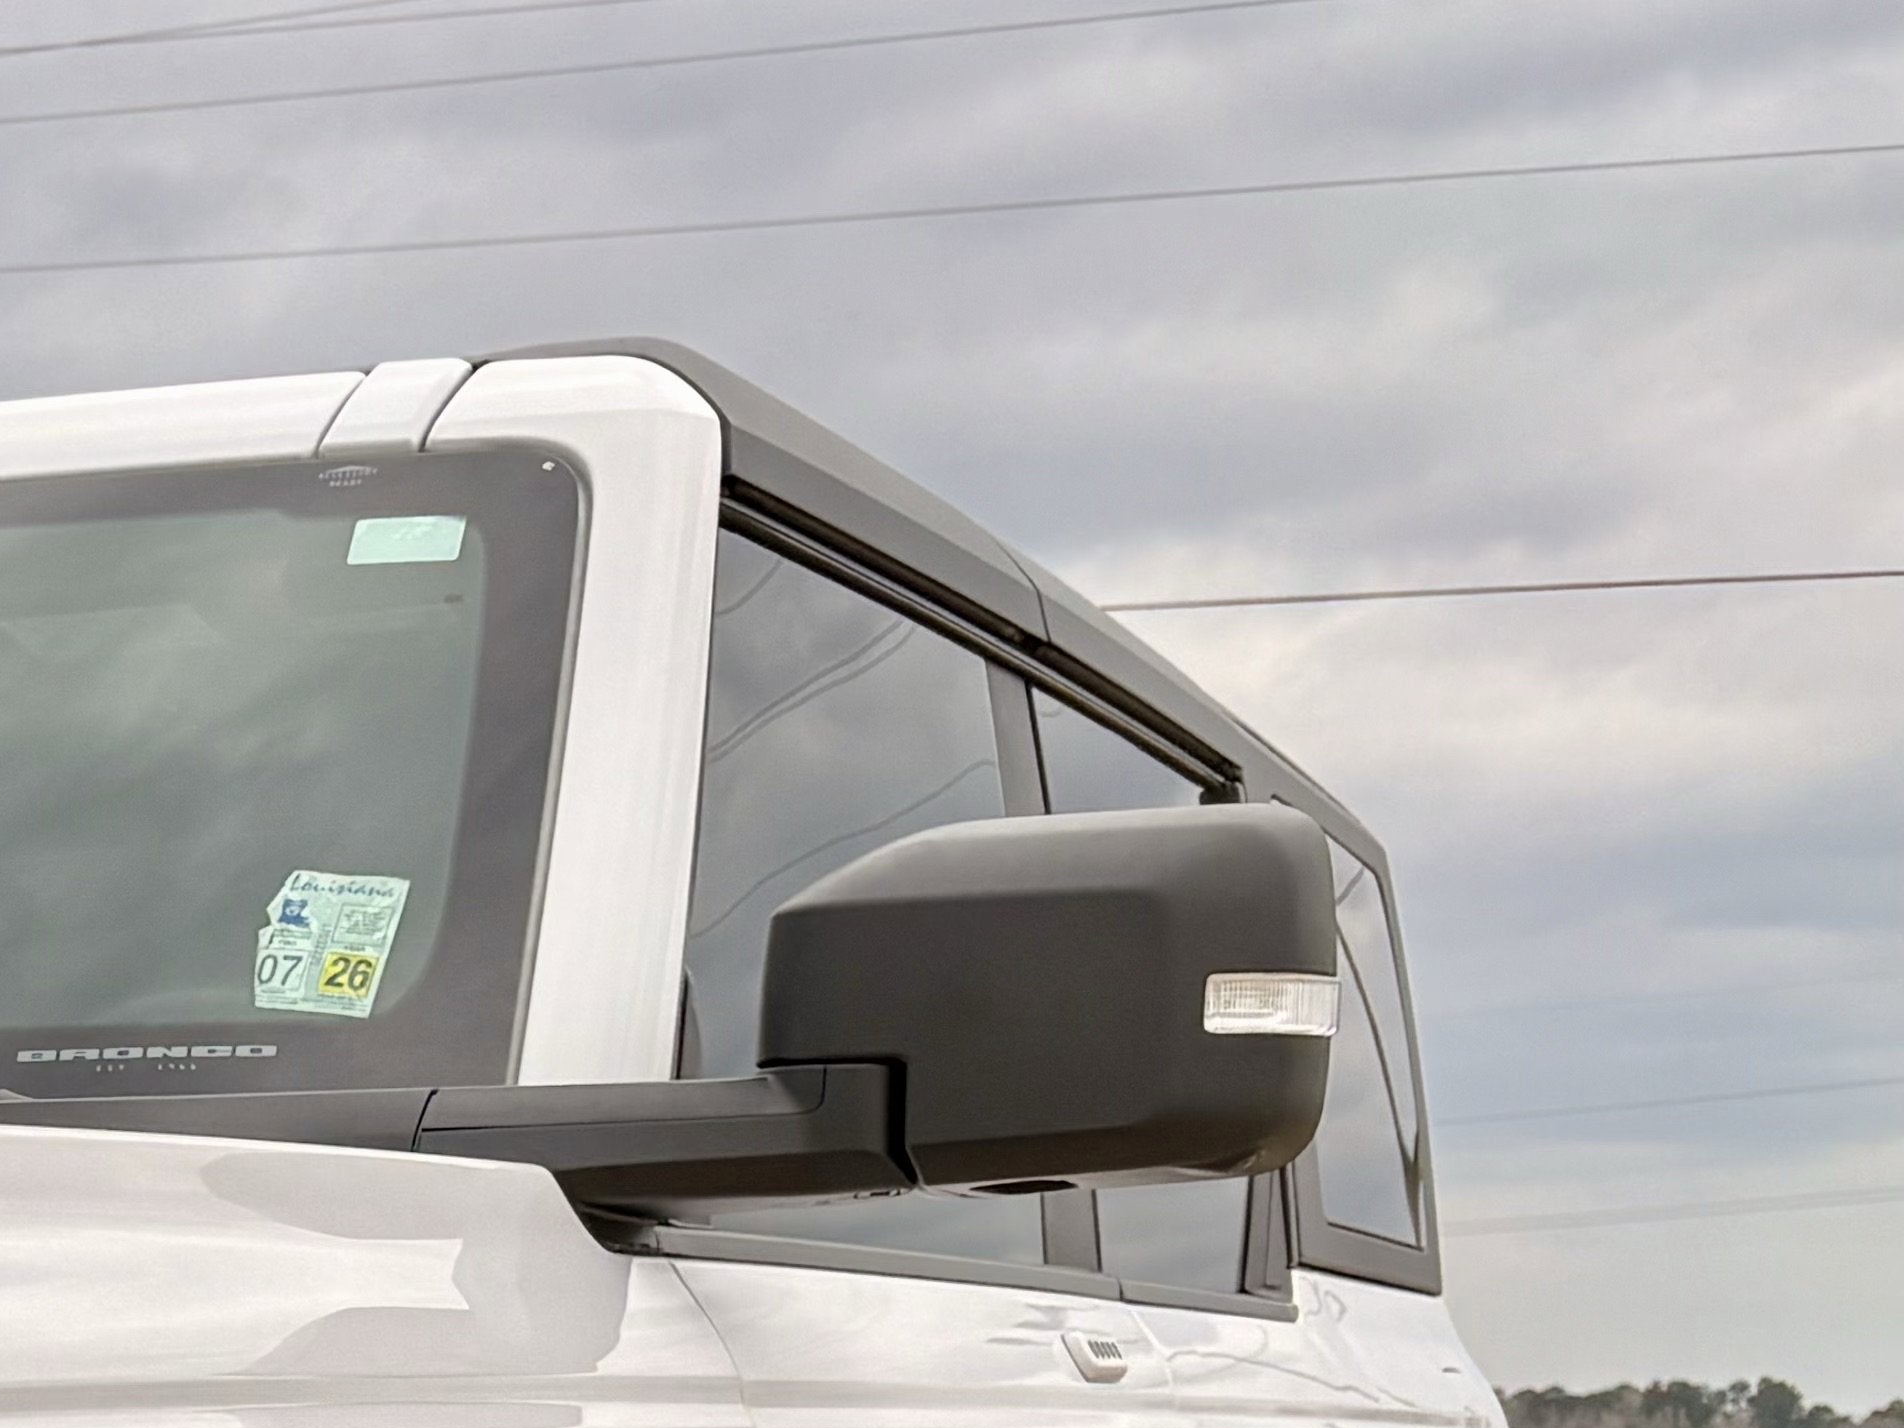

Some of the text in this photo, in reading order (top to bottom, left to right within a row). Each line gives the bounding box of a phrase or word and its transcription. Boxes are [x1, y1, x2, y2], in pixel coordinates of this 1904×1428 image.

[289, 872, 396, 898] Louisiana
[257, 954, 304, 987] 07
[324, 956, 373, 992] 26
[16, 1045, 278, 1062] BRONCO
